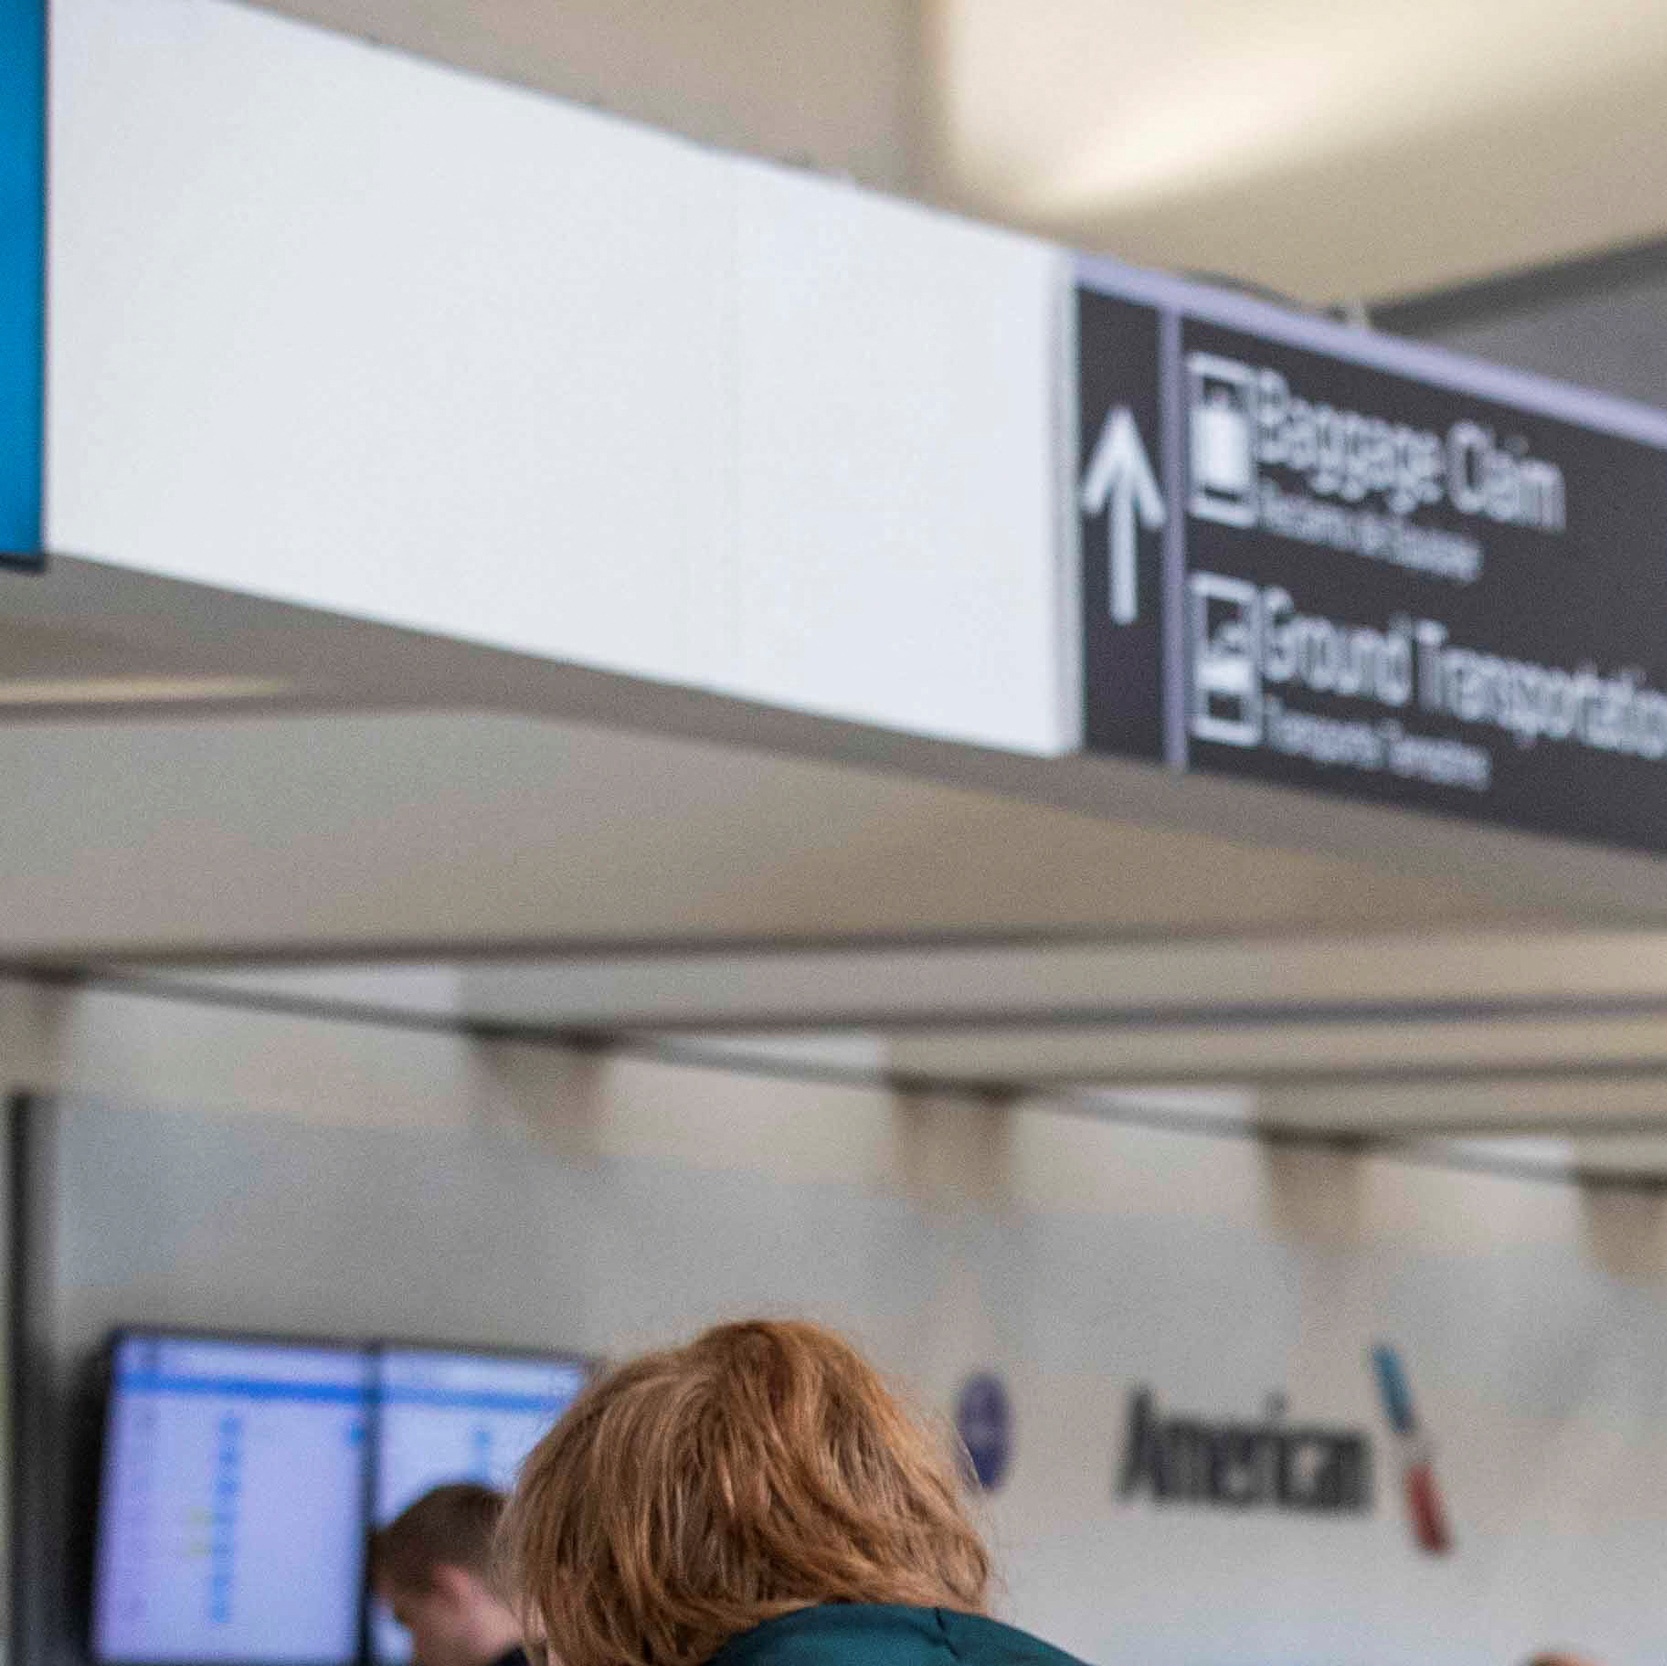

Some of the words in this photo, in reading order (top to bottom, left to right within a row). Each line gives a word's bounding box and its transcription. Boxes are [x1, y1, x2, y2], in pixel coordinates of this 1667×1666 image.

[1255, 370, 1443, 514] Baggage
[1446, 420, 1567, 533] Claim
[1261, 587, 1411, 706] Ground
[1110, 1386, 1373, 1511] American
